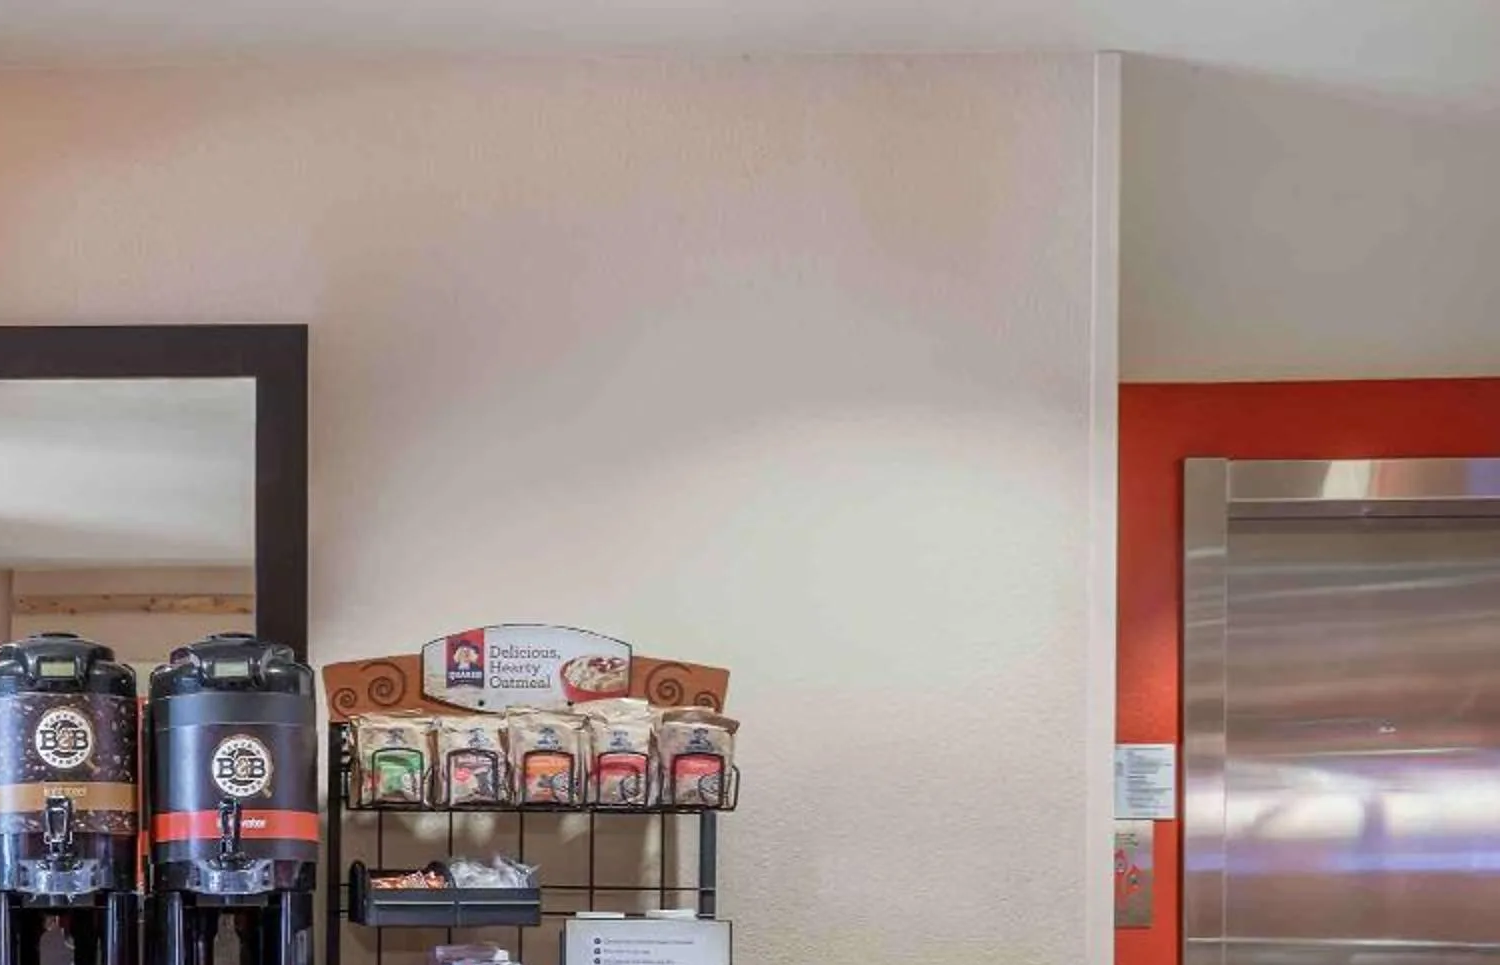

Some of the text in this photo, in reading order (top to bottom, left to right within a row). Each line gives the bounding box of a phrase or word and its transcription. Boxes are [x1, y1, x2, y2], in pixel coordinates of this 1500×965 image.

[489, 645, 561, 660] Delicious,
[489, 660, 540, 676] Hearty
[489, 675, 551, 689] Oatmeal
